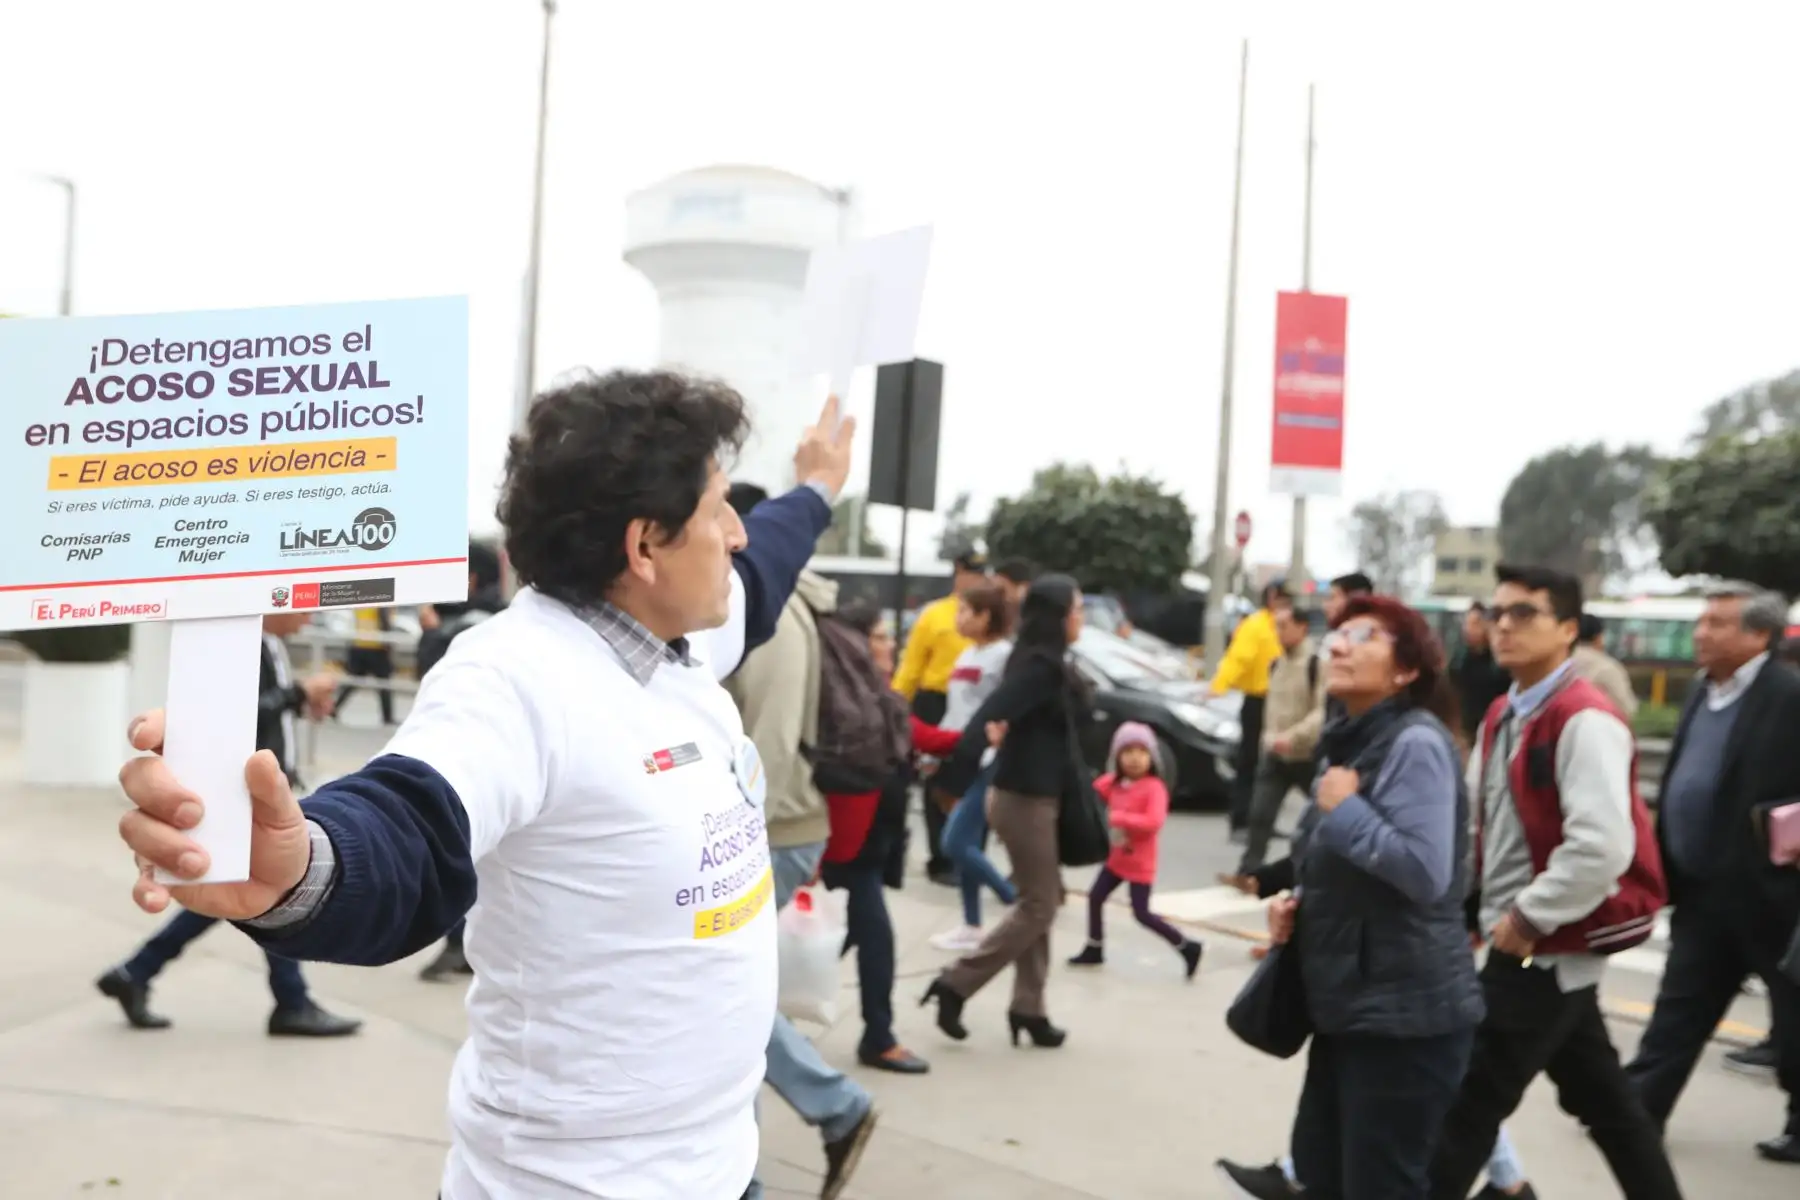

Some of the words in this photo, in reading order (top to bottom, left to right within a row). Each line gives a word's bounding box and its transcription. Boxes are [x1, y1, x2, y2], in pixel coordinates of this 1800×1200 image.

[89, 333, 332, 373] ¡Detengamos
[342, 323, 372, 353] el
[64, 370, 215, 406] ACOSO
[227, 360, 391, 397] SEXUAL
[24, 421, 70, 447] en
[82, 408, 249, 448] espacios
[260, 394, 424, 440] públicos!
[78, 459, 107, 483] El
[113, 460, 198, 482] acoso
[207, 456, 238, 476] es
[249, 446, 367, 473] violencia
[47, 500, 62, 514] Si
[66, 502, 97, 512] eres
[102, 497, 154, 512] víctima,
[158, 494, 190, 511] pide
[193, 491, 239, 508] ayuda.
[245, 489, 259, 502] Si
[263, 489, 294, 501] eres
[298, 485, 346, 501] testigo,
[351, 480, 392, 496] actúa.
[174, 517, 228, 533] Centro
[40, 531, 131, 548] Comisarías
[154, 531, 250, 551] Emergencia
[66, 547, 104, 562] PNP
[178, 549, 226, 564] Mujer
[59, 602, 96, 620] PERÚ
[99, 600, 161, 618] PRIMERO
[676, 884, 704, 907] en
